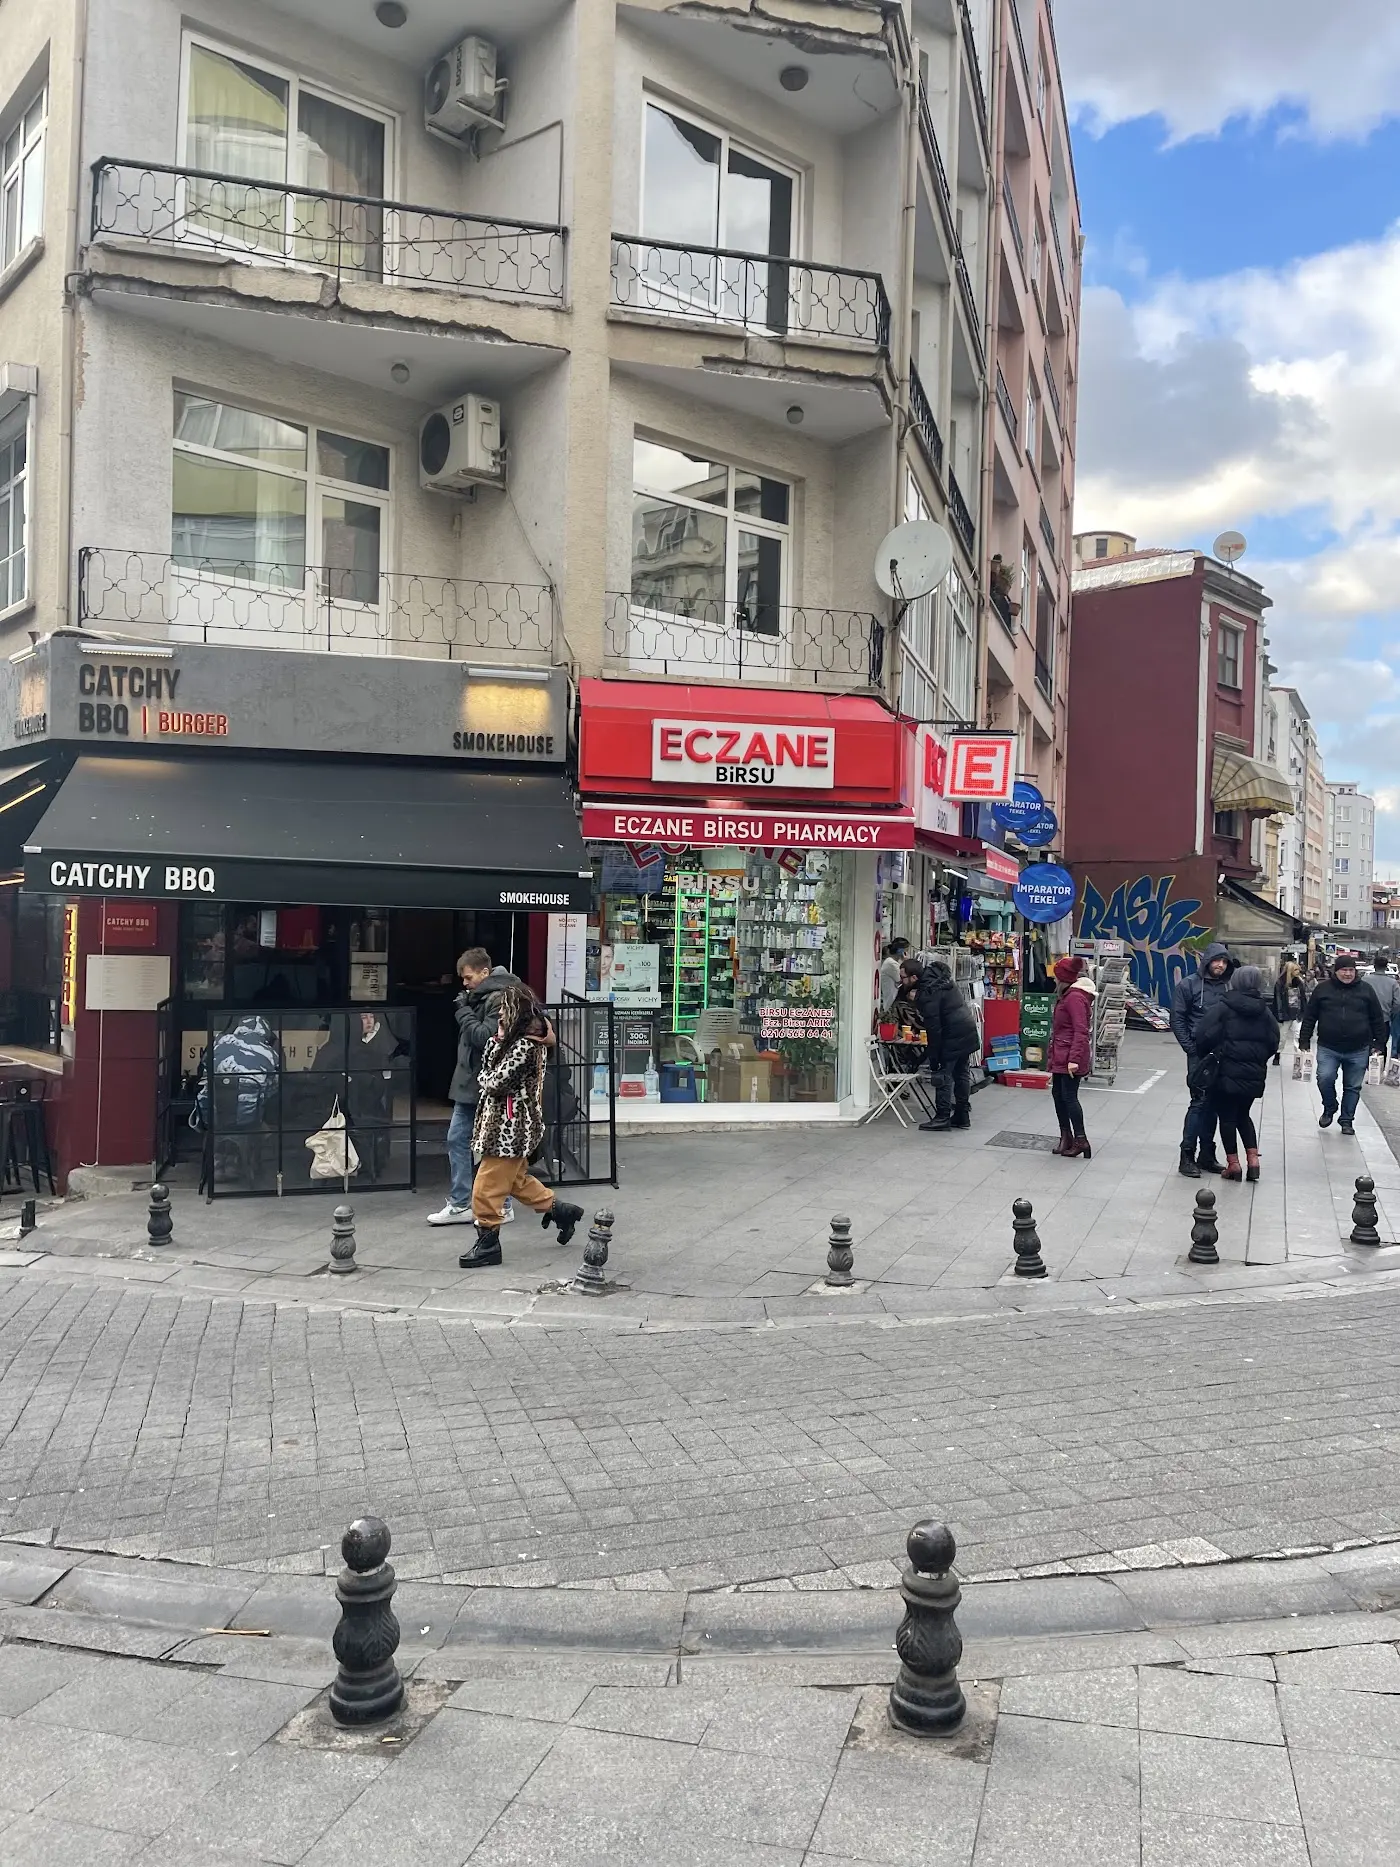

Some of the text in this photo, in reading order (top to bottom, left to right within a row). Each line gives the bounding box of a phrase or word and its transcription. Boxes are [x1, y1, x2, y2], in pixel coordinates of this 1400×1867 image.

[79, 663, 181, 699] CATCHY
[78, 702, 228, 736] BBQ BURGER
[452, 731, 554, 754] SMOKEHOUSE
[660, 726, 829, 768] ECZANE
[963, 746, 997, 790] E
[613, 815, 881, 843] ECZANE BİRSU PHARMACY
[50, 861, 216, 893] CATCHY BBQ
[500, 892, 570, 905] SMOKEHOUSE
[1028, 895, 1058, 905] TEKEL
[106, 918, 134, 926] CATCHY
[759, 1006, 787, 1017] BİRSU
[806, 1018, 831, 1027] ARIK
[760, 1029, 786, 1038] 0216
